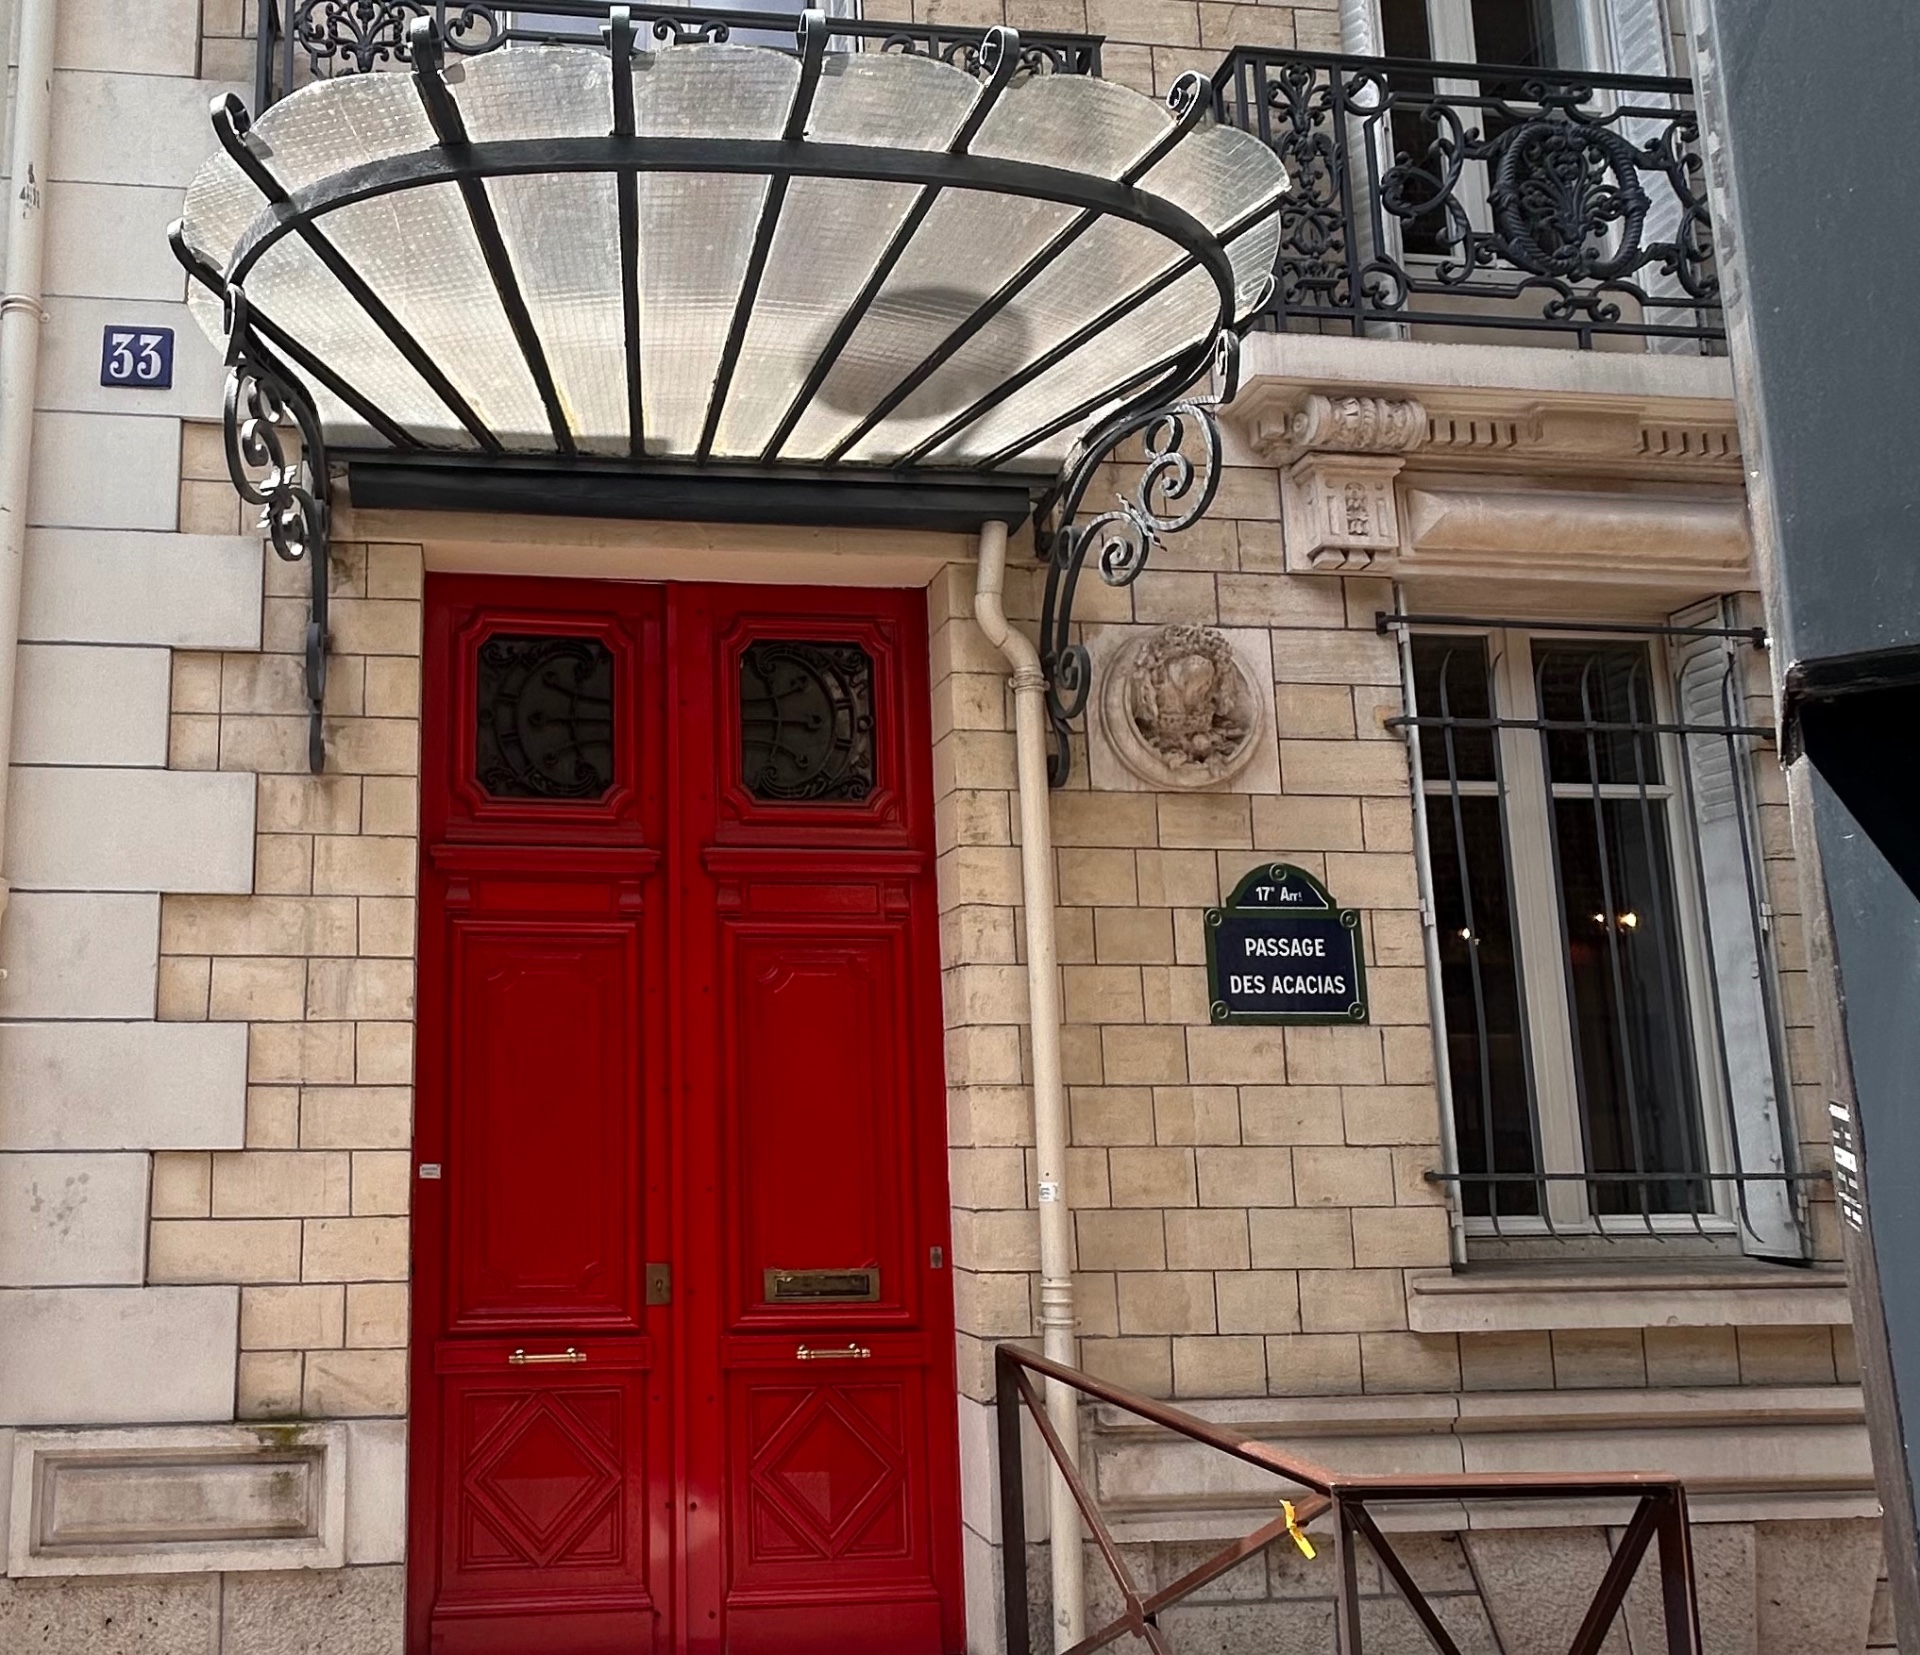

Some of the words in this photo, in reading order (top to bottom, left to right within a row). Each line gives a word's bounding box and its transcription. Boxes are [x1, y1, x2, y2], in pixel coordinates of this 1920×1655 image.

[109, 333, 163, 379] 33
[1244, 938, 1326, 957] PASSAGE
[1230, 975, 1266, 994] DES
[1271, 975, 1346, 994] ACACIAS
